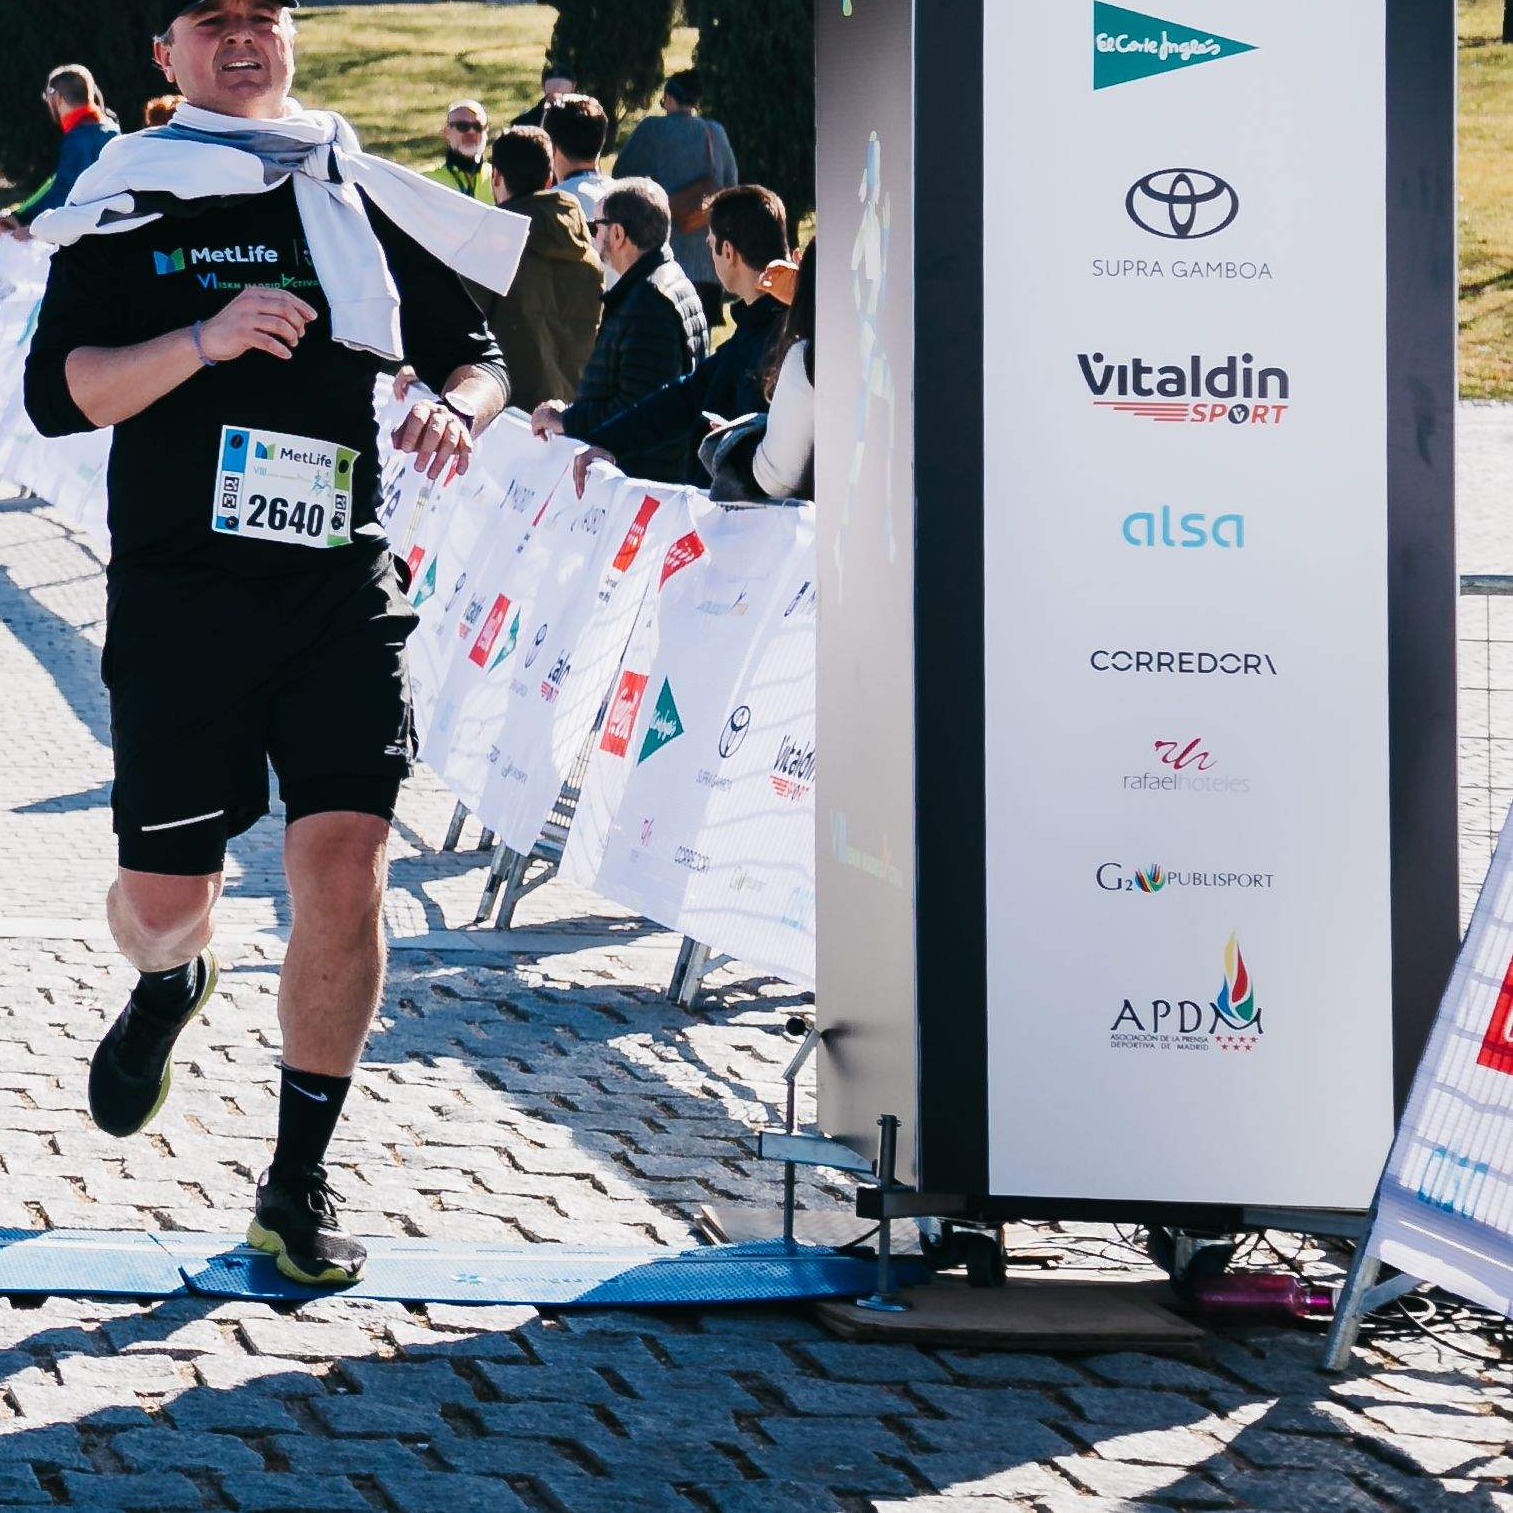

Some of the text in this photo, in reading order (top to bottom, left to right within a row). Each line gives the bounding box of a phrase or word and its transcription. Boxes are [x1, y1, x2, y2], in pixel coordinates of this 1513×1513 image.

[1096, 31, 1221, 61] El Corte Inglés
[190, 245, 279, 265] MetLife
[1092, 259, 1273, 280] SUPRA GAMBOA
[1077, 352, 1289, 399] Vitaldin
[1190, 404, 1289, 424] SPORT
[280, 448, 332, 468] MetLife
[246, 494, 325, 538] 2640
[1122, 505, 1245, 549] alsa
[1167, 871, 1273, 889] PUBLISPORT
[1110, 998, 1264, 1035] APDM
[1110, 1041, 1156, 1050] DEPORTIVA
[1177, 1043, 1209, 1051] MADRID
